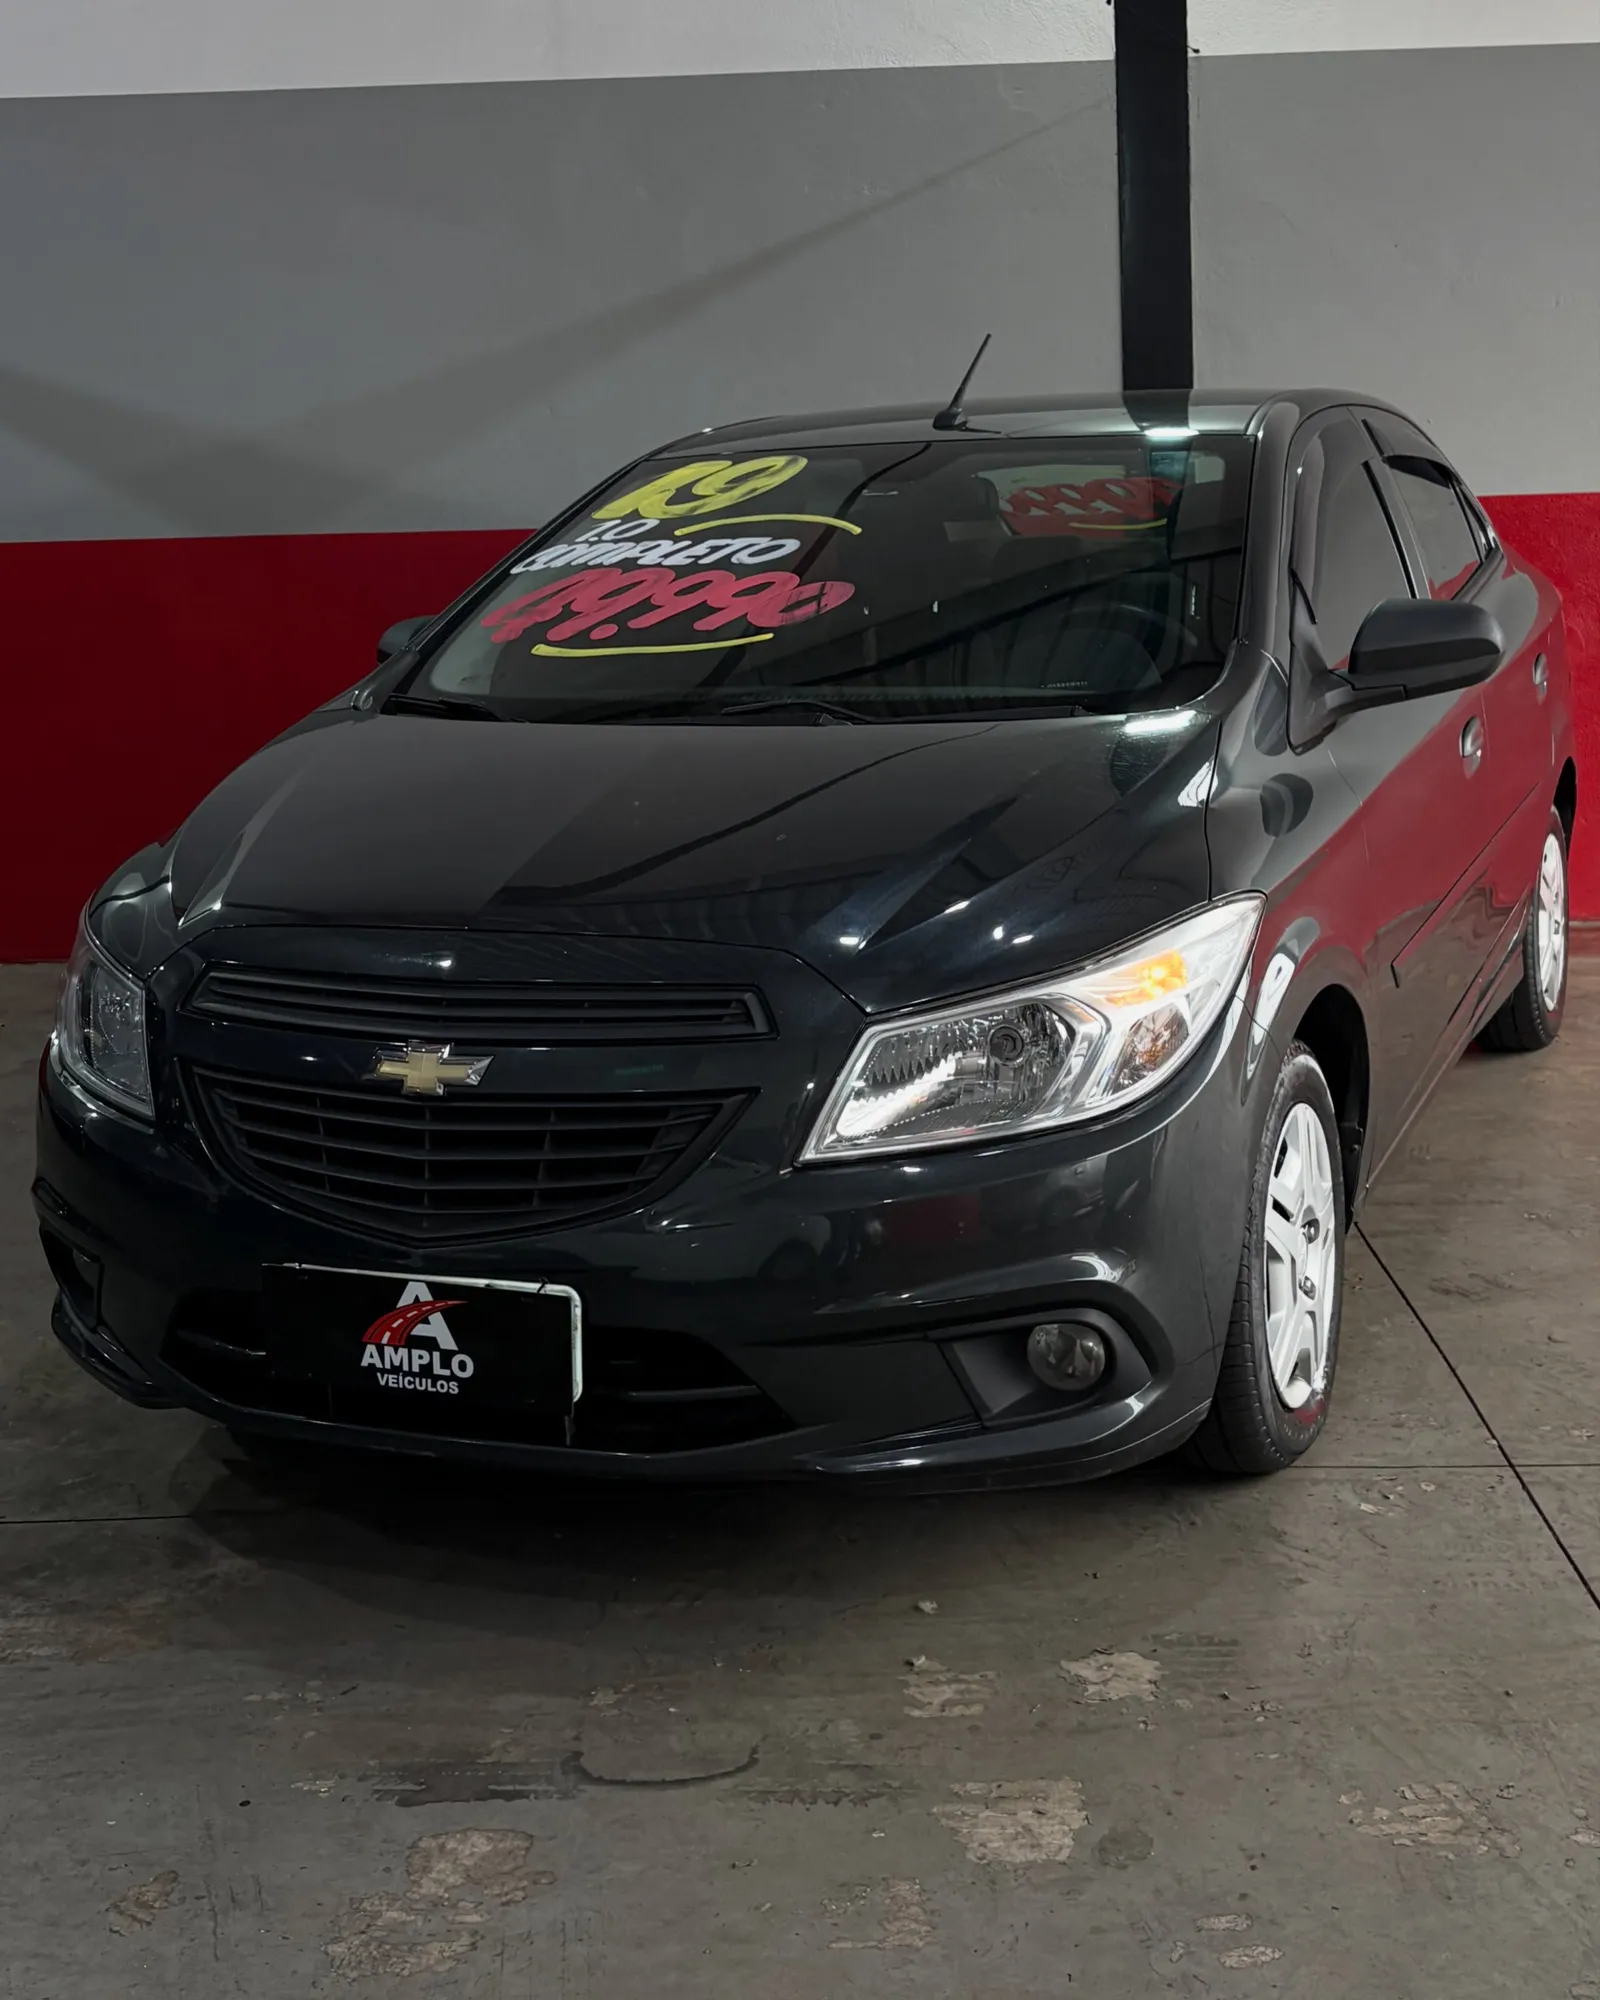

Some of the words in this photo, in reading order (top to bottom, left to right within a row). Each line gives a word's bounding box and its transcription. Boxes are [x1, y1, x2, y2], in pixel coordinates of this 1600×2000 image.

[574, 518, 660, 542] 1.0
[510, 537, 801, 574] COMPLETO
[481, 567, 856, 643] 49.990
[360, 1344, 475, 1379] AMPLO
[376, 1372, 460, 1395] VEÍCULOS
